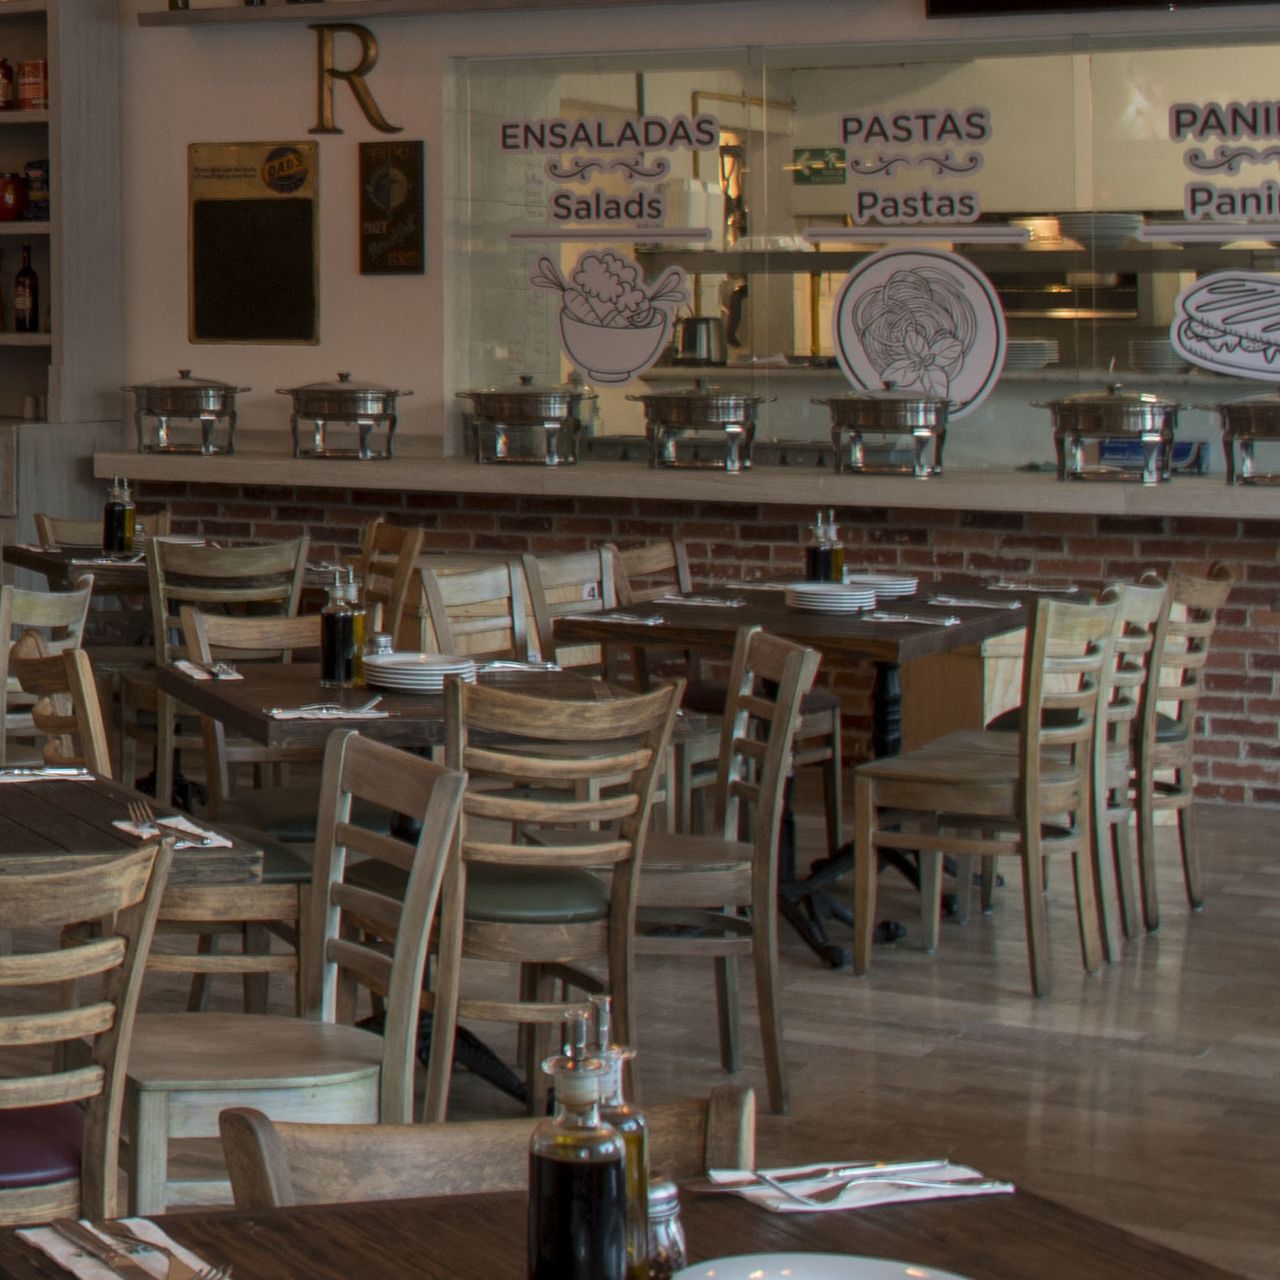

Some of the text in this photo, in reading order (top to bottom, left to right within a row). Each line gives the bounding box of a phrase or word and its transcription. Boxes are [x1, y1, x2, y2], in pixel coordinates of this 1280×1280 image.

[308, 22, 404, 134] R
[501, 119, 716, 150] ENSALADAS
[842, 112, 985, 144] PASTAS
[553, 192, 663, 220] Salads
[857, 191, 975, 219] Pastas
